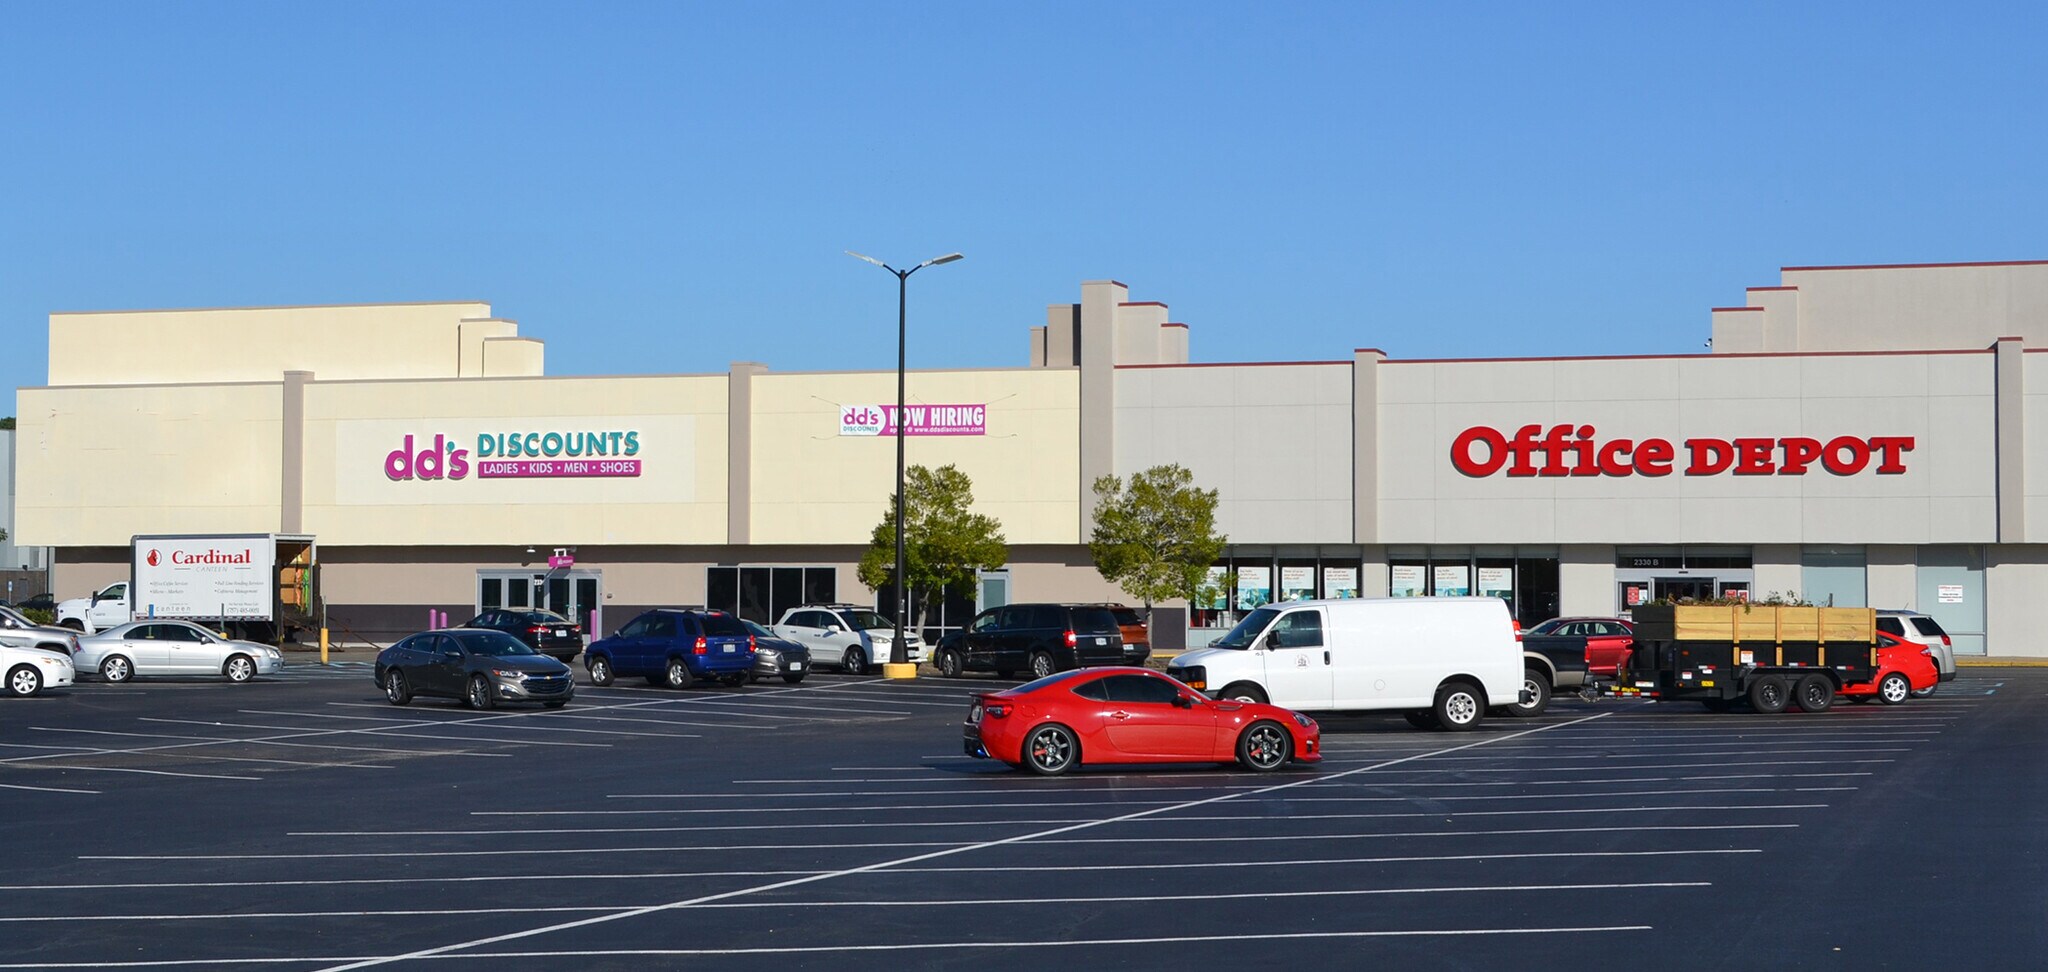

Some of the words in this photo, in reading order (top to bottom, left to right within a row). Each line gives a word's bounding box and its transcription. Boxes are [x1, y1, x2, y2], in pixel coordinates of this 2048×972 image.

[843, 408, 879, 425] dd's
[889, 407, 926, 427] NOW
[930, 407, 984, 426] HIRING
[384, 434, 470, 481] dd's
[477, 431, 640, 457] DISCOUNTS
[1450, 424, 1674, 477] Office
[1684, 436, 1915, 477] DEPOT
[483, 463, 519, 474] LADIES
[529, 463, 553, 474] KIDS
[563, 463, 588, 473] MEN
[600, 462, 635, 473] SHOES
[172, 549, 251, 565] Cardinal
